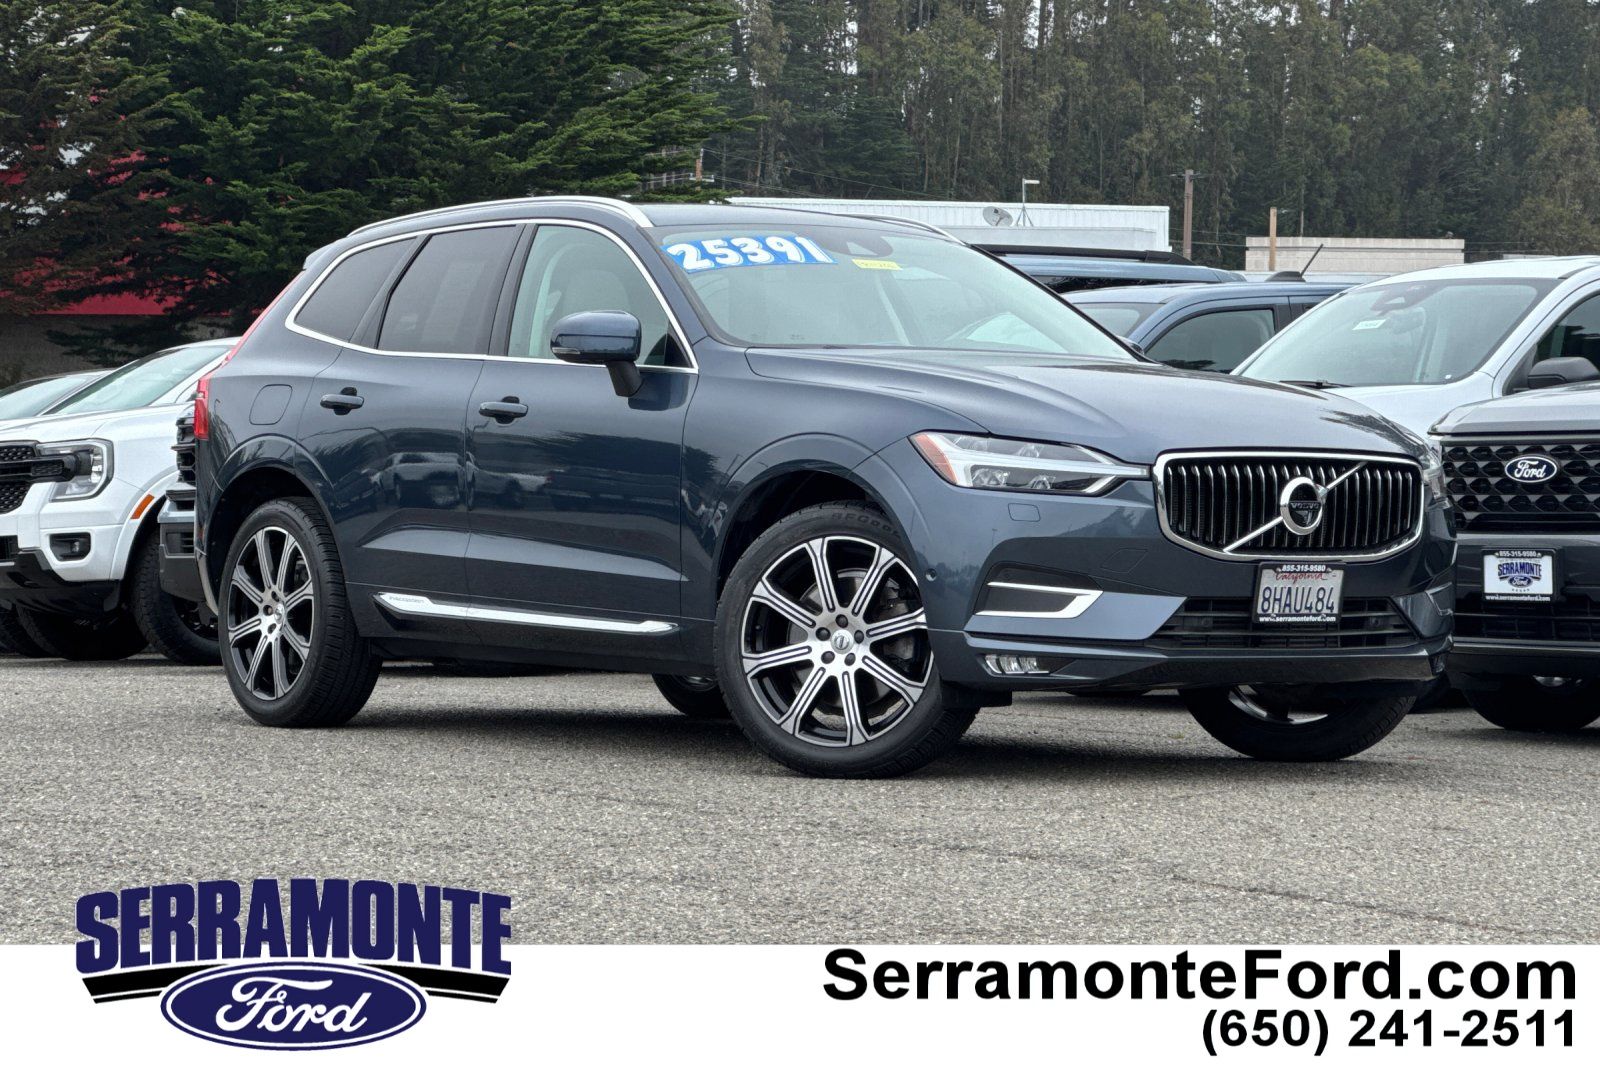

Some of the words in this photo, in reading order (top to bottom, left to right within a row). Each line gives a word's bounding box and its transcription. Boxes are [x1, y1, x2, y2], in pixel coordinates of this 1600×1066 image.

[666, 236, 834, 271] 25391
[1515, 460, 1547, 478] Ford
[1498, 562, 1542, 576] SERRAMONTE
[1261, 586, 1334, 613] 8HAU484
